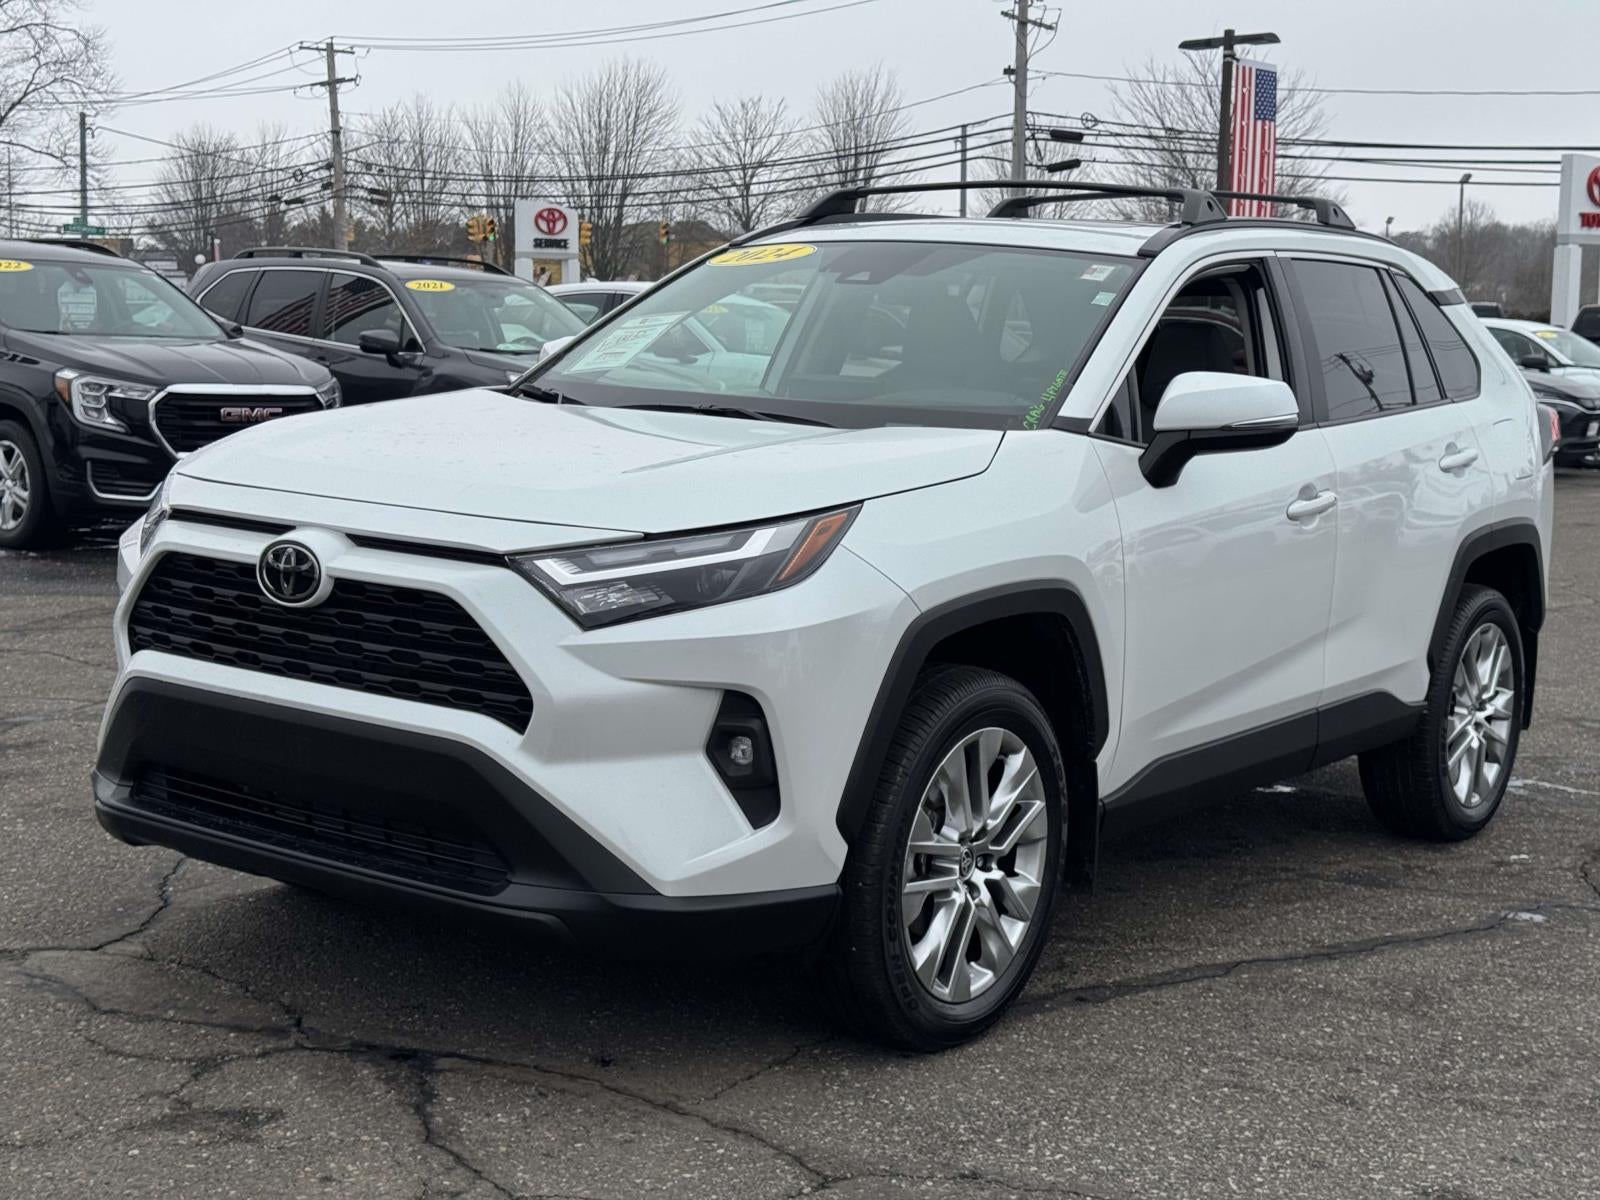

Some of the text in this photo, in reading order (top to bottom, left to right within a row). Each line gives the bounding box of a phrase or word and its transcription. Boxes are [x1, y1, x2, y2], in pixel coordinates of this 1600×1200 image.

[532, 238, 569, 249] SERVICE
[415, 281, 444, 290] 2021
[220, 407, 283, 422] GMC
